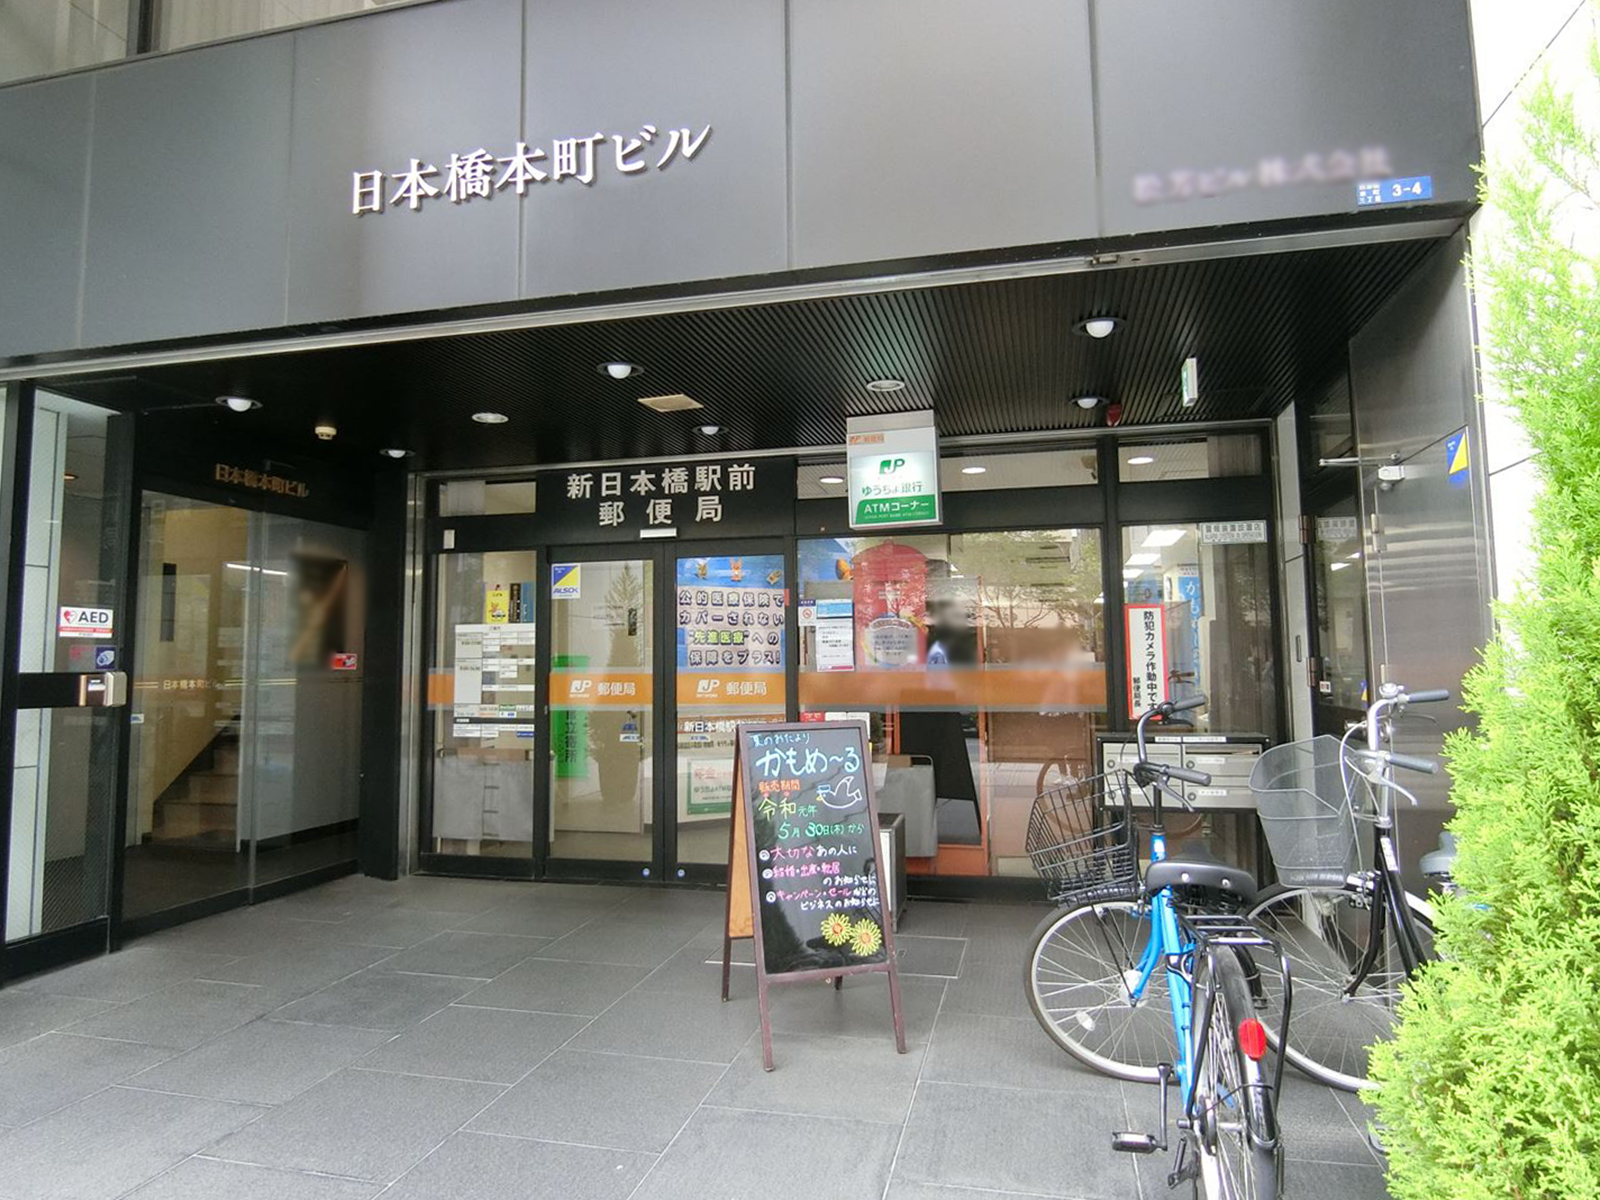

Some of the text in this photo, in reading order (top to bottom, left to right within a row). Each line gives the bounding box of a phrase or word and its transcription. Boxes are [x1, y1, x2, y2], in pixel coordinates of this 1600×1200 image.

[350, 123, 713, 217] 日本橋本町ビル
[1392, 181, 1422, 198] 3-4
[214, 462, 310, 498] 日本橋本町ビル
[566, 463, 756, 500] 新日本橋駅前
[861, 481, 924, 497] ゆうちょ銀行
[598, 495, 723, 527] 郵便局
[863, 500, 930, 514] ATMコーナー
[552, 586, 579, 594] ALSOK
[678, 589, 784, 607] 公的医療保険で
[78, 611, 109, 624] AED
[679, 609, 784, 627] カバーされない
[1143, 610, 1160, 711] 防犯カメラ作動中です
[597, 681, 635, 696] 郵便局
[725, 681, 767, 696] 郵便局
[1132, 676, 1142, 708] 郵便局長
[750, 732, 810, 747] 夏のおたより
[758, 779, 801, 793] 販売期間
[769, 844, 858, 861] 大切なあの人に
[822, 874, 877, 886] のお知らせに
